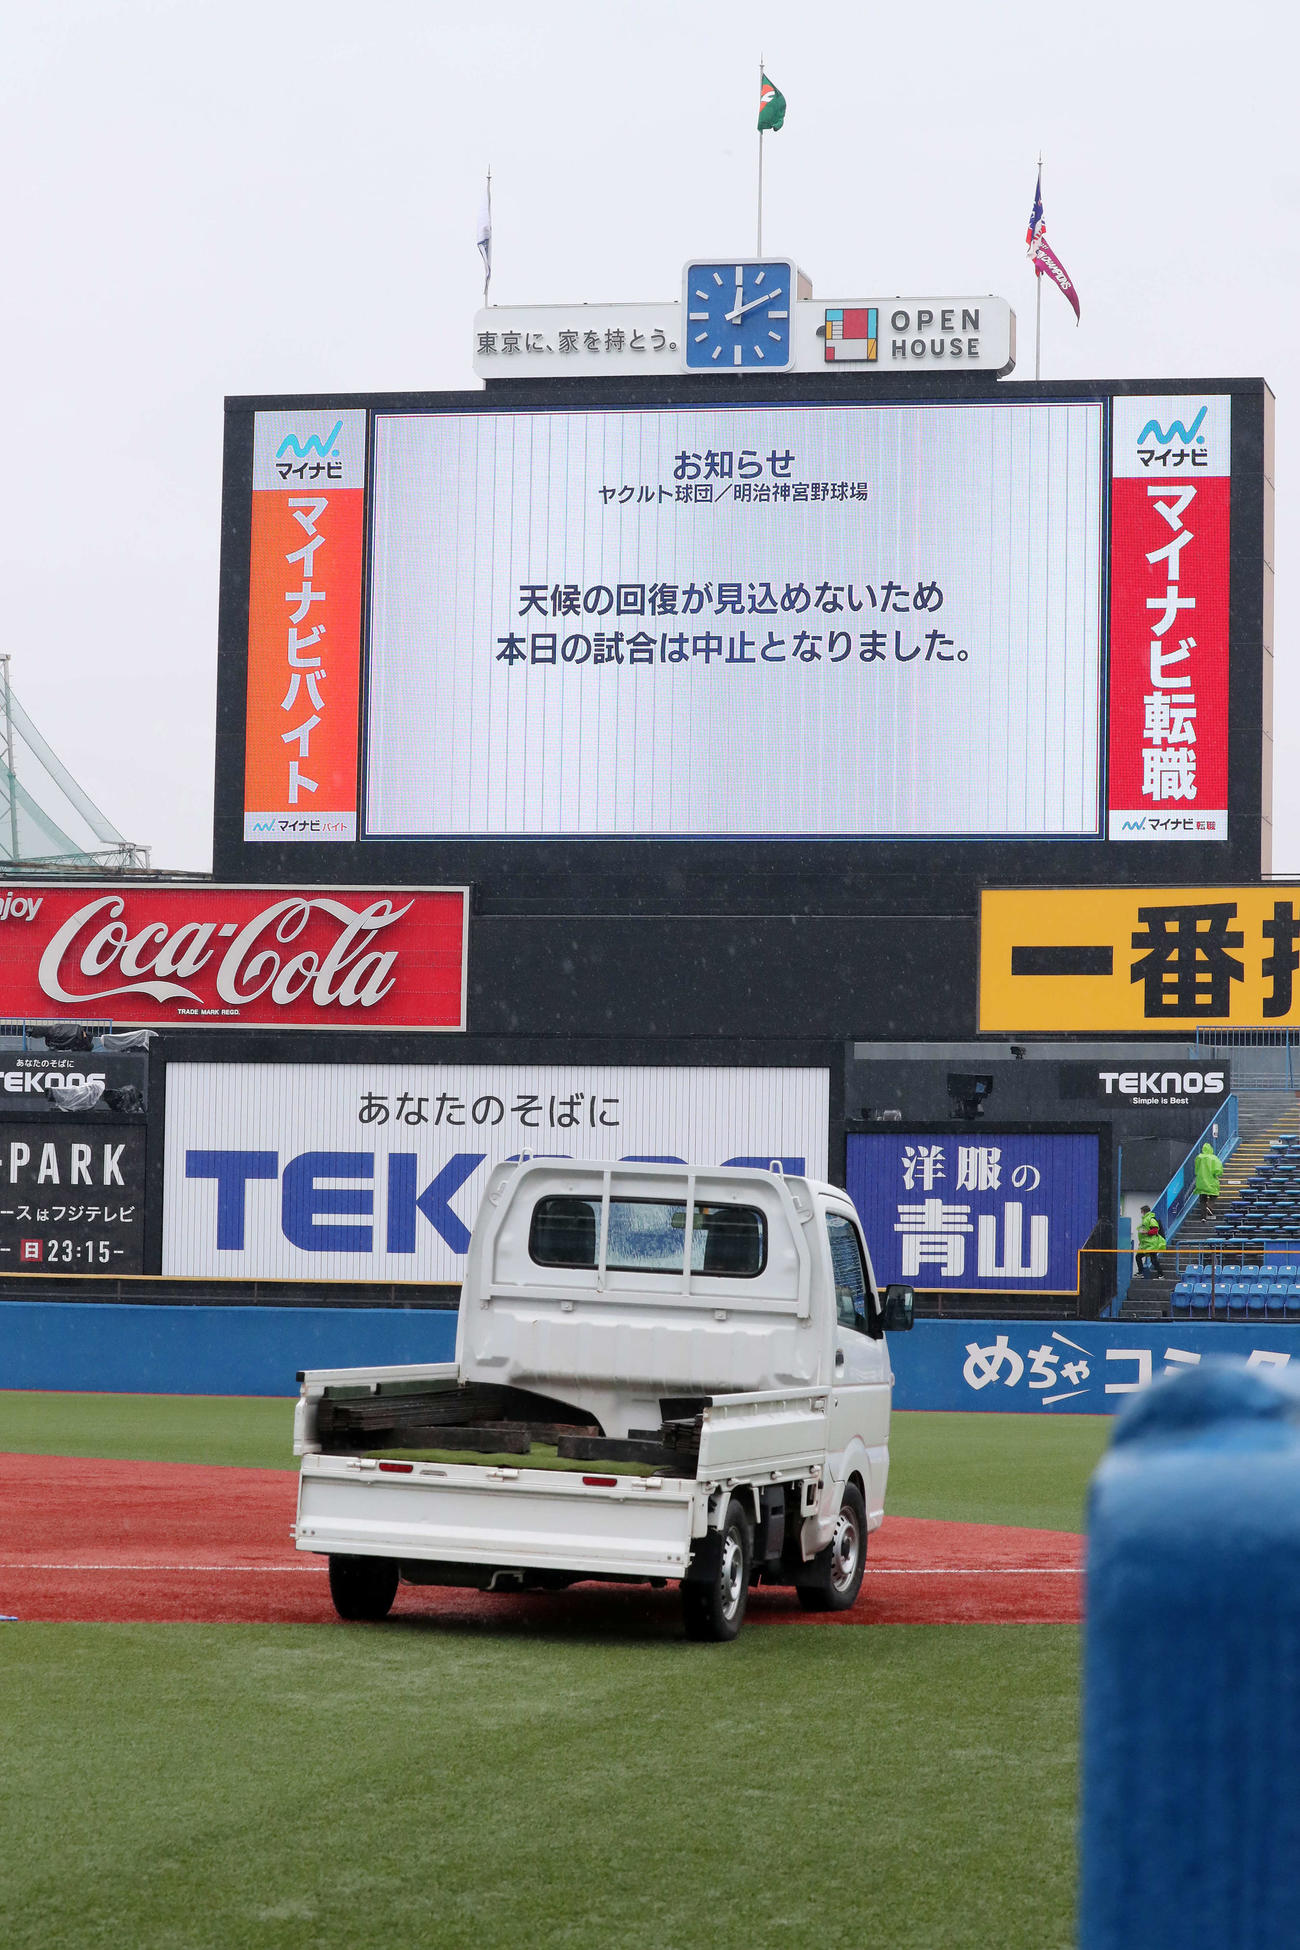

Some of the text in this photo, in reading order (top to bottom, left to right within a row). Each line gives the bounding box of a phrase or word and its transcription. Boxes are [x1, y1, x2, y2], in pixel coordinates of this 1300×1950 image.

[891, 308, 981, 332] OPEN
[476, 329, 679, 355] 東京に、家を持とう。
[891, 337, 981, 358] HOUSE
[275, 462, 343, 480] マイナビ
[672, 449, 796, 481] お知らせ
[1137, 448, 1208, 467] マイナビ
[518, 581, 944, 616] 天候の回復が見込めないため
[280, 497, 329, 804] マイナビバイト
[496, 629, 969, 665] 本日の試合は中止となりました。
[1142, 485, 1198, 801] マイナビ転職
[0, 891, 44, 921] joy
[38, 895, 415, 1007] Coca-Cola
[15, 1058, 75, 1068] あなたのそばに
[1098, 1072, 1225, 1094] TEKNOS
[358, 1090, 621, 1127] あなたのそばに
[1132, 1097, 1189, 1106] Simple is Best
[901, 1145, 1041, 1192] 洋服の
[894, 1198, 1049, 1278] 青山
